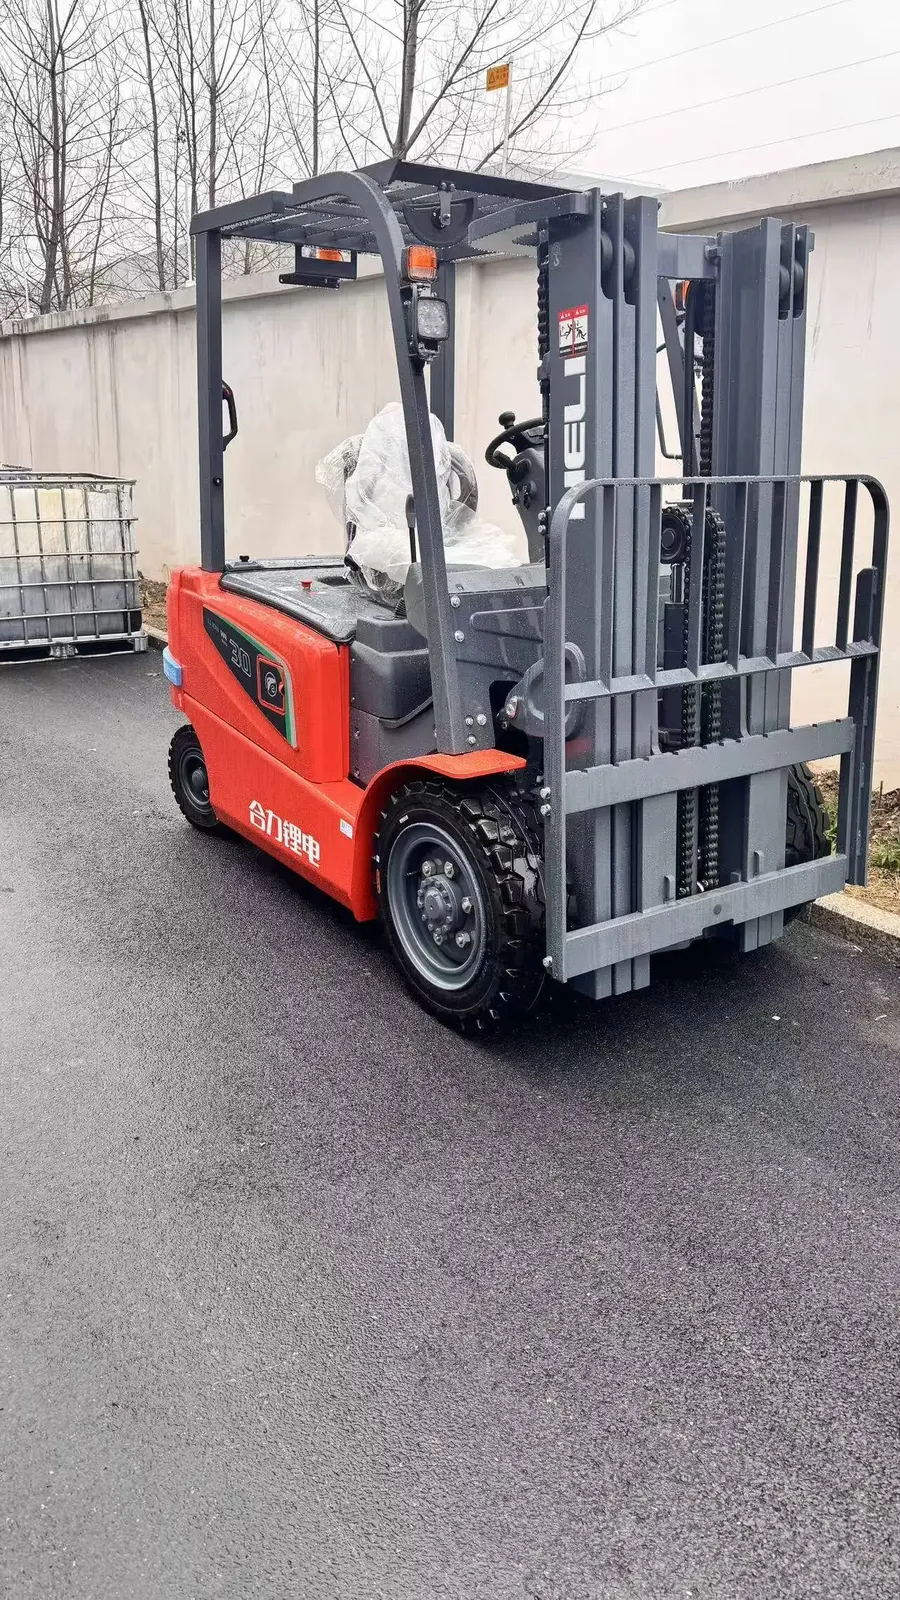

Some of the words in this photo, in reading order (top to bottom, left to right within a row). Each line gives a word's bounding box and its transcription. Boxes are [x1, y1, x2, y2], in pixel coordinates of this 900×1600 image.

[229, 638, 252, 678] 30
[248, 799, 321, 869] 合力锂电
